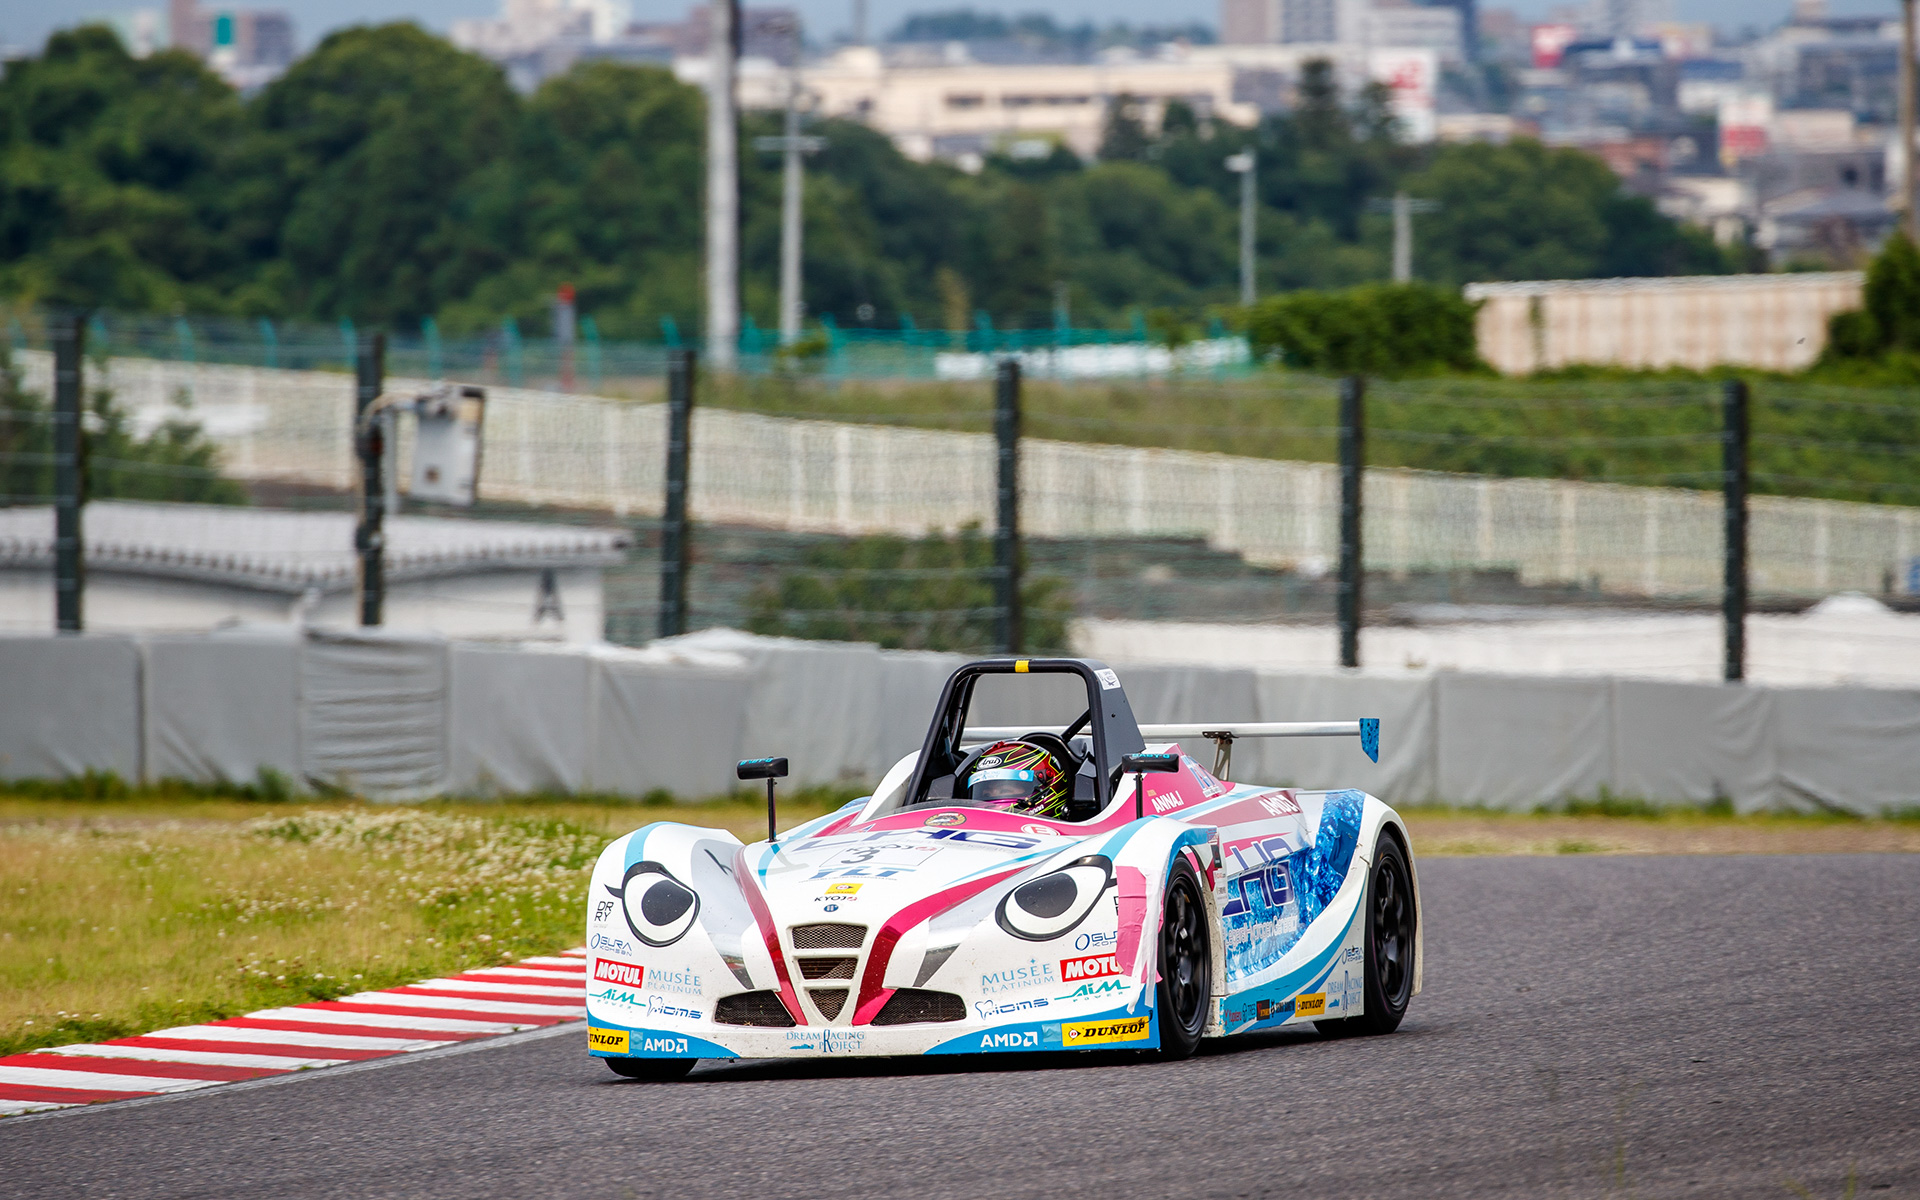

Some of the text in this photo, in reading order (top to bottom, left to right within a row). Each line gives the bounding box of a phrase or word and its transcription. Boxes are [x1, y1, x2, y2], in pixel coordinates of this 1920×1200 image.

[841, 849, 881, 864] 3
[1075, 931, 1118, 951] OGU
[595, 961, 641, 985] MOTUL
[1065, 956, 1119, 979] MOTU
[647, 981, 702, 995] PLATINUM
[982, 976, 1055, 994] PLATINUM
[1301, 999, 1323, 1010] DUNLOP
[786, 1031, 821, 1040] DREAM
[1083, 1022, 1145, 1038] DUNLOP
[644, 1038, 676, 1052] AMD
[980, 1033, 1022, 1047] AMD
